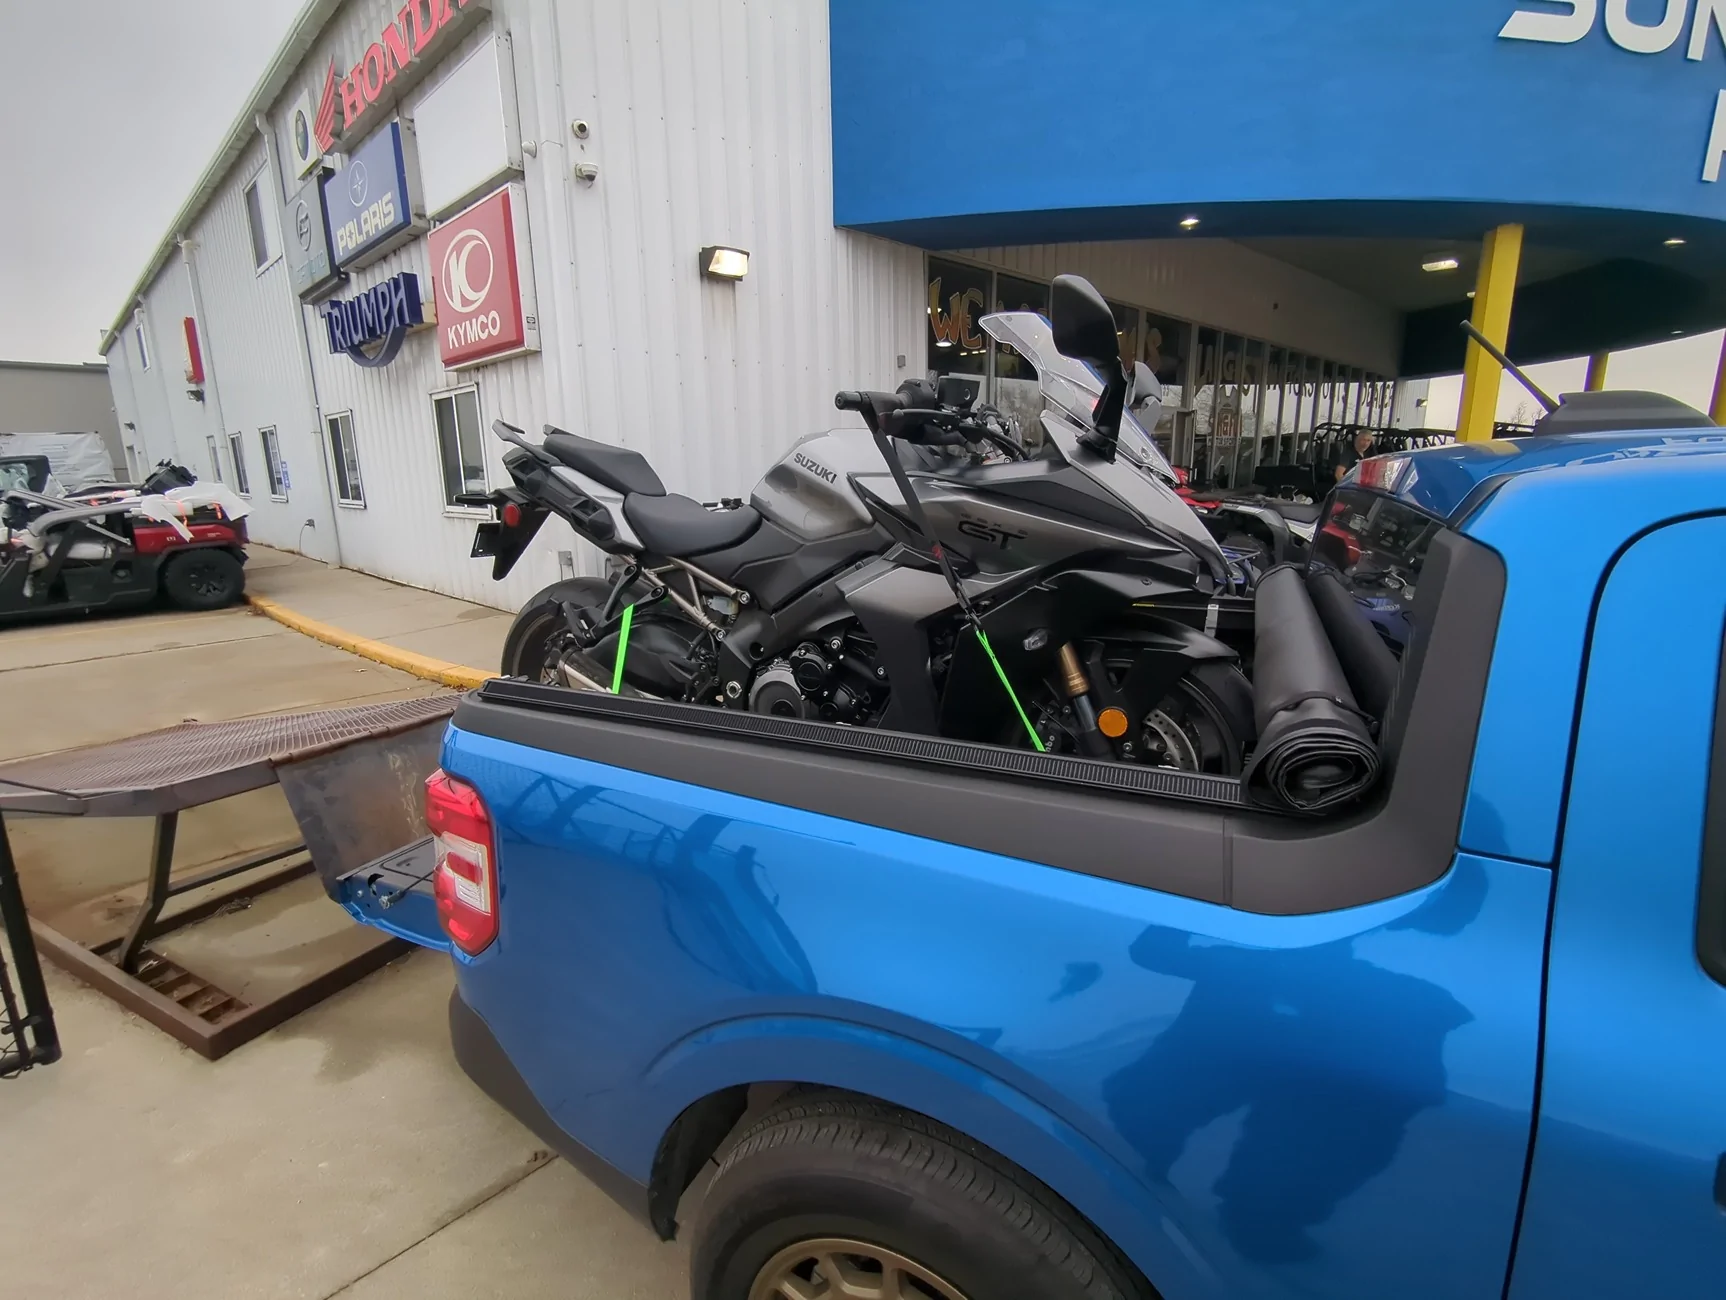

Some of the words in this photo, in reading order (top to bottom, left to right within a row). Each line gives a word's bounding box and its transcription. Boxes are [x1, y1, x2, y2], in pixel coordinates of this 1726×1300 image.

[336, 191, 395, 257] POLARIS
[320, 273, 410, 354] TRIUMPH
[447, 310, 500, 350] KYMCO
[929, 277, 984, 350] WE
[793, 452, 837, 485] SUZUKI
